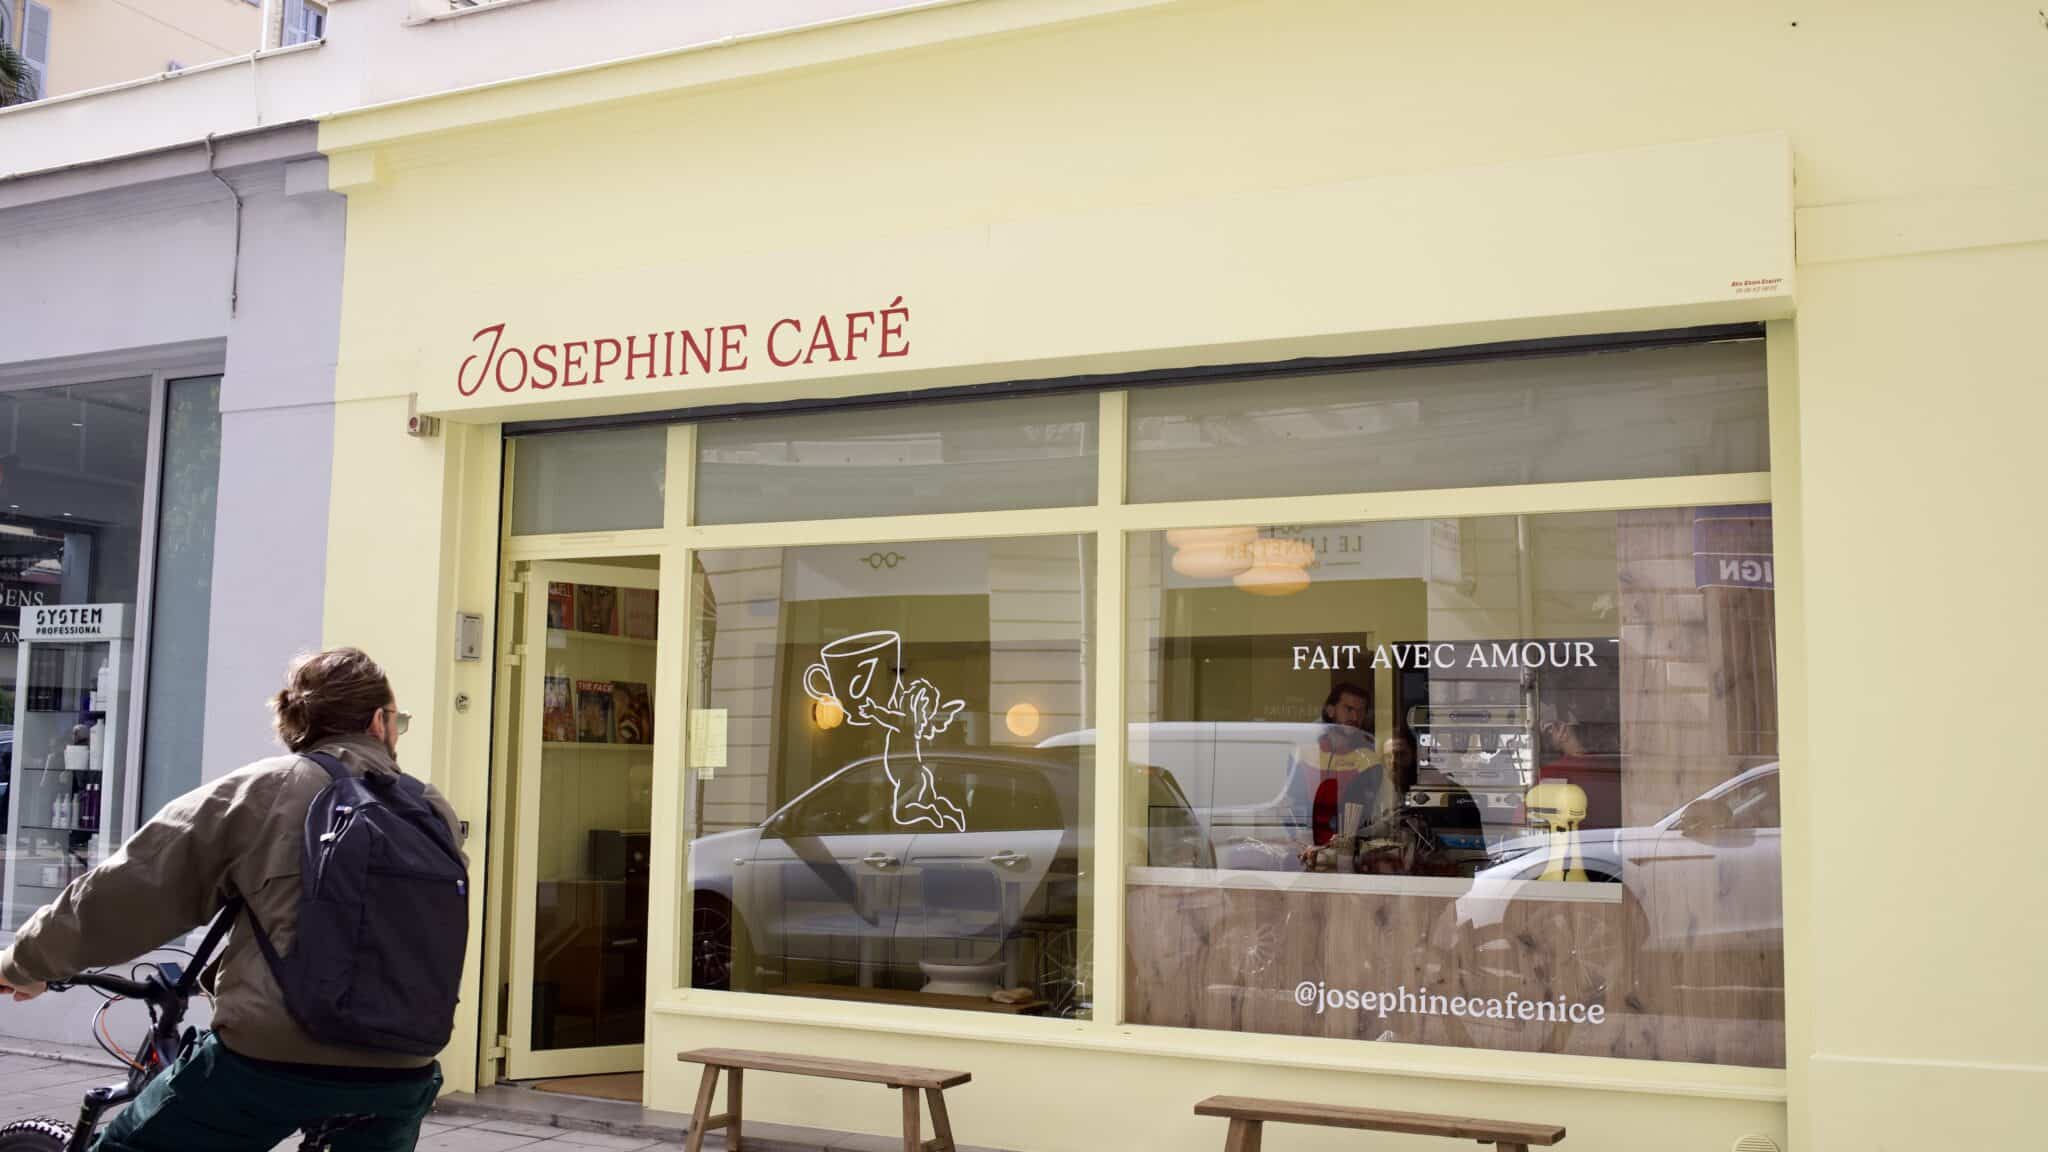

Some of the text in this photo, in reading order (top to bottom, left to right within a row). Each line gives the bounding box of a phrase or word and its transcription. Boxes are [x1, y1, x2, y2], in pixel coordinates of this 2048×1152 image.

[458, 296, 911, 397] JOSEPHINE CAFÉ
[36, 607, 103, 625] SYSTEM
[36, 626, 102, 635] PROFESSIONAL
[1292, 641, 1598, 670] FAIT AVEC AMOUR
[1294, 980, 1606, 1025] @josephinecafenice
